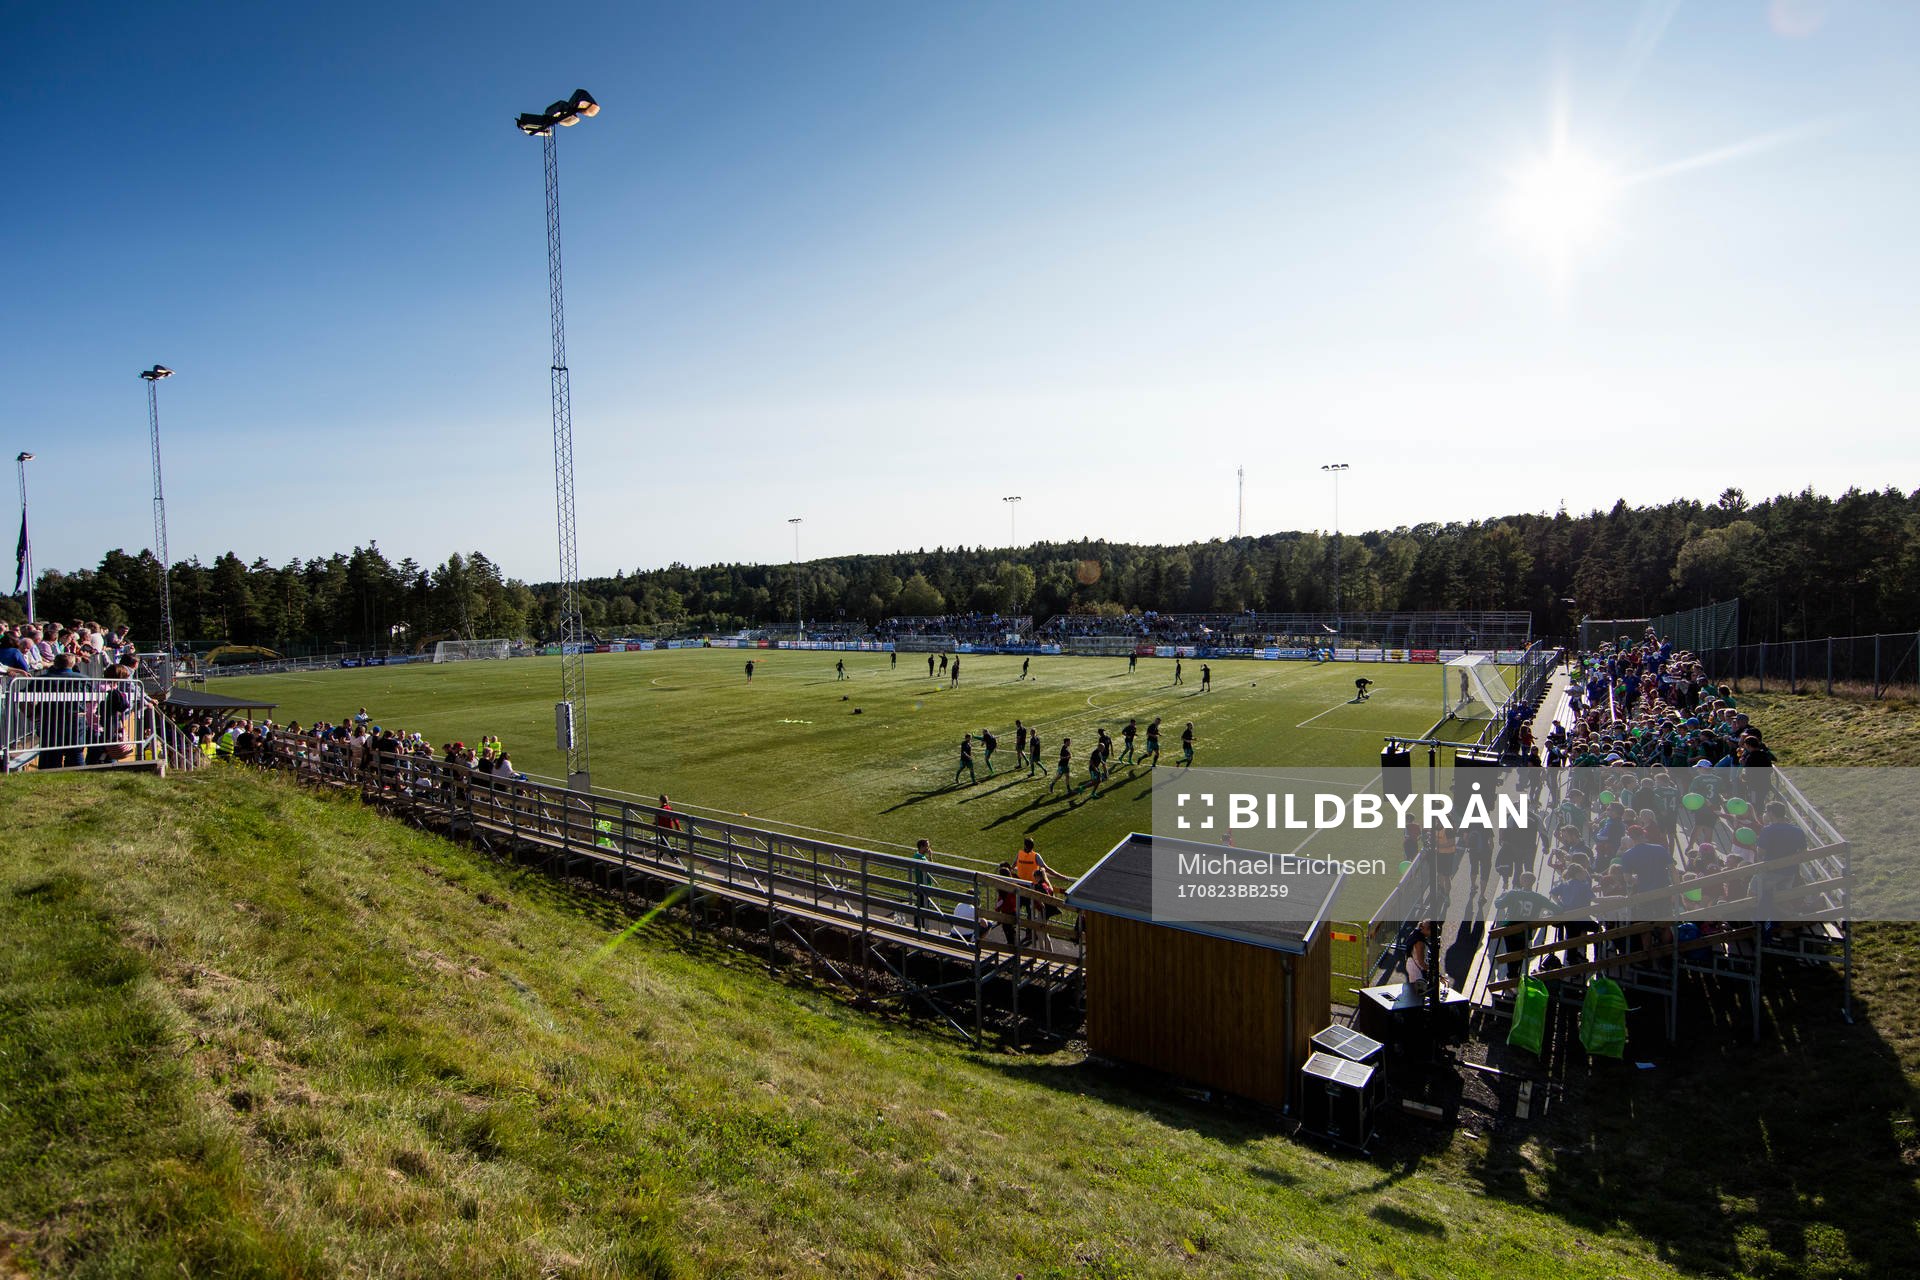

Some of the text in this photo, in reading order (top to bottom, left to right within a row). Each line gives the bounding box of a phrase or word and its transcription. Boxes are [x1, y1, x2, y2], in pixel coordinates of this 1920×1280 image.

[1706, 783, 1714, 799] 3
[1664, 796, 1677, 811] 14
[1518, 900, 1534, 917] 19
